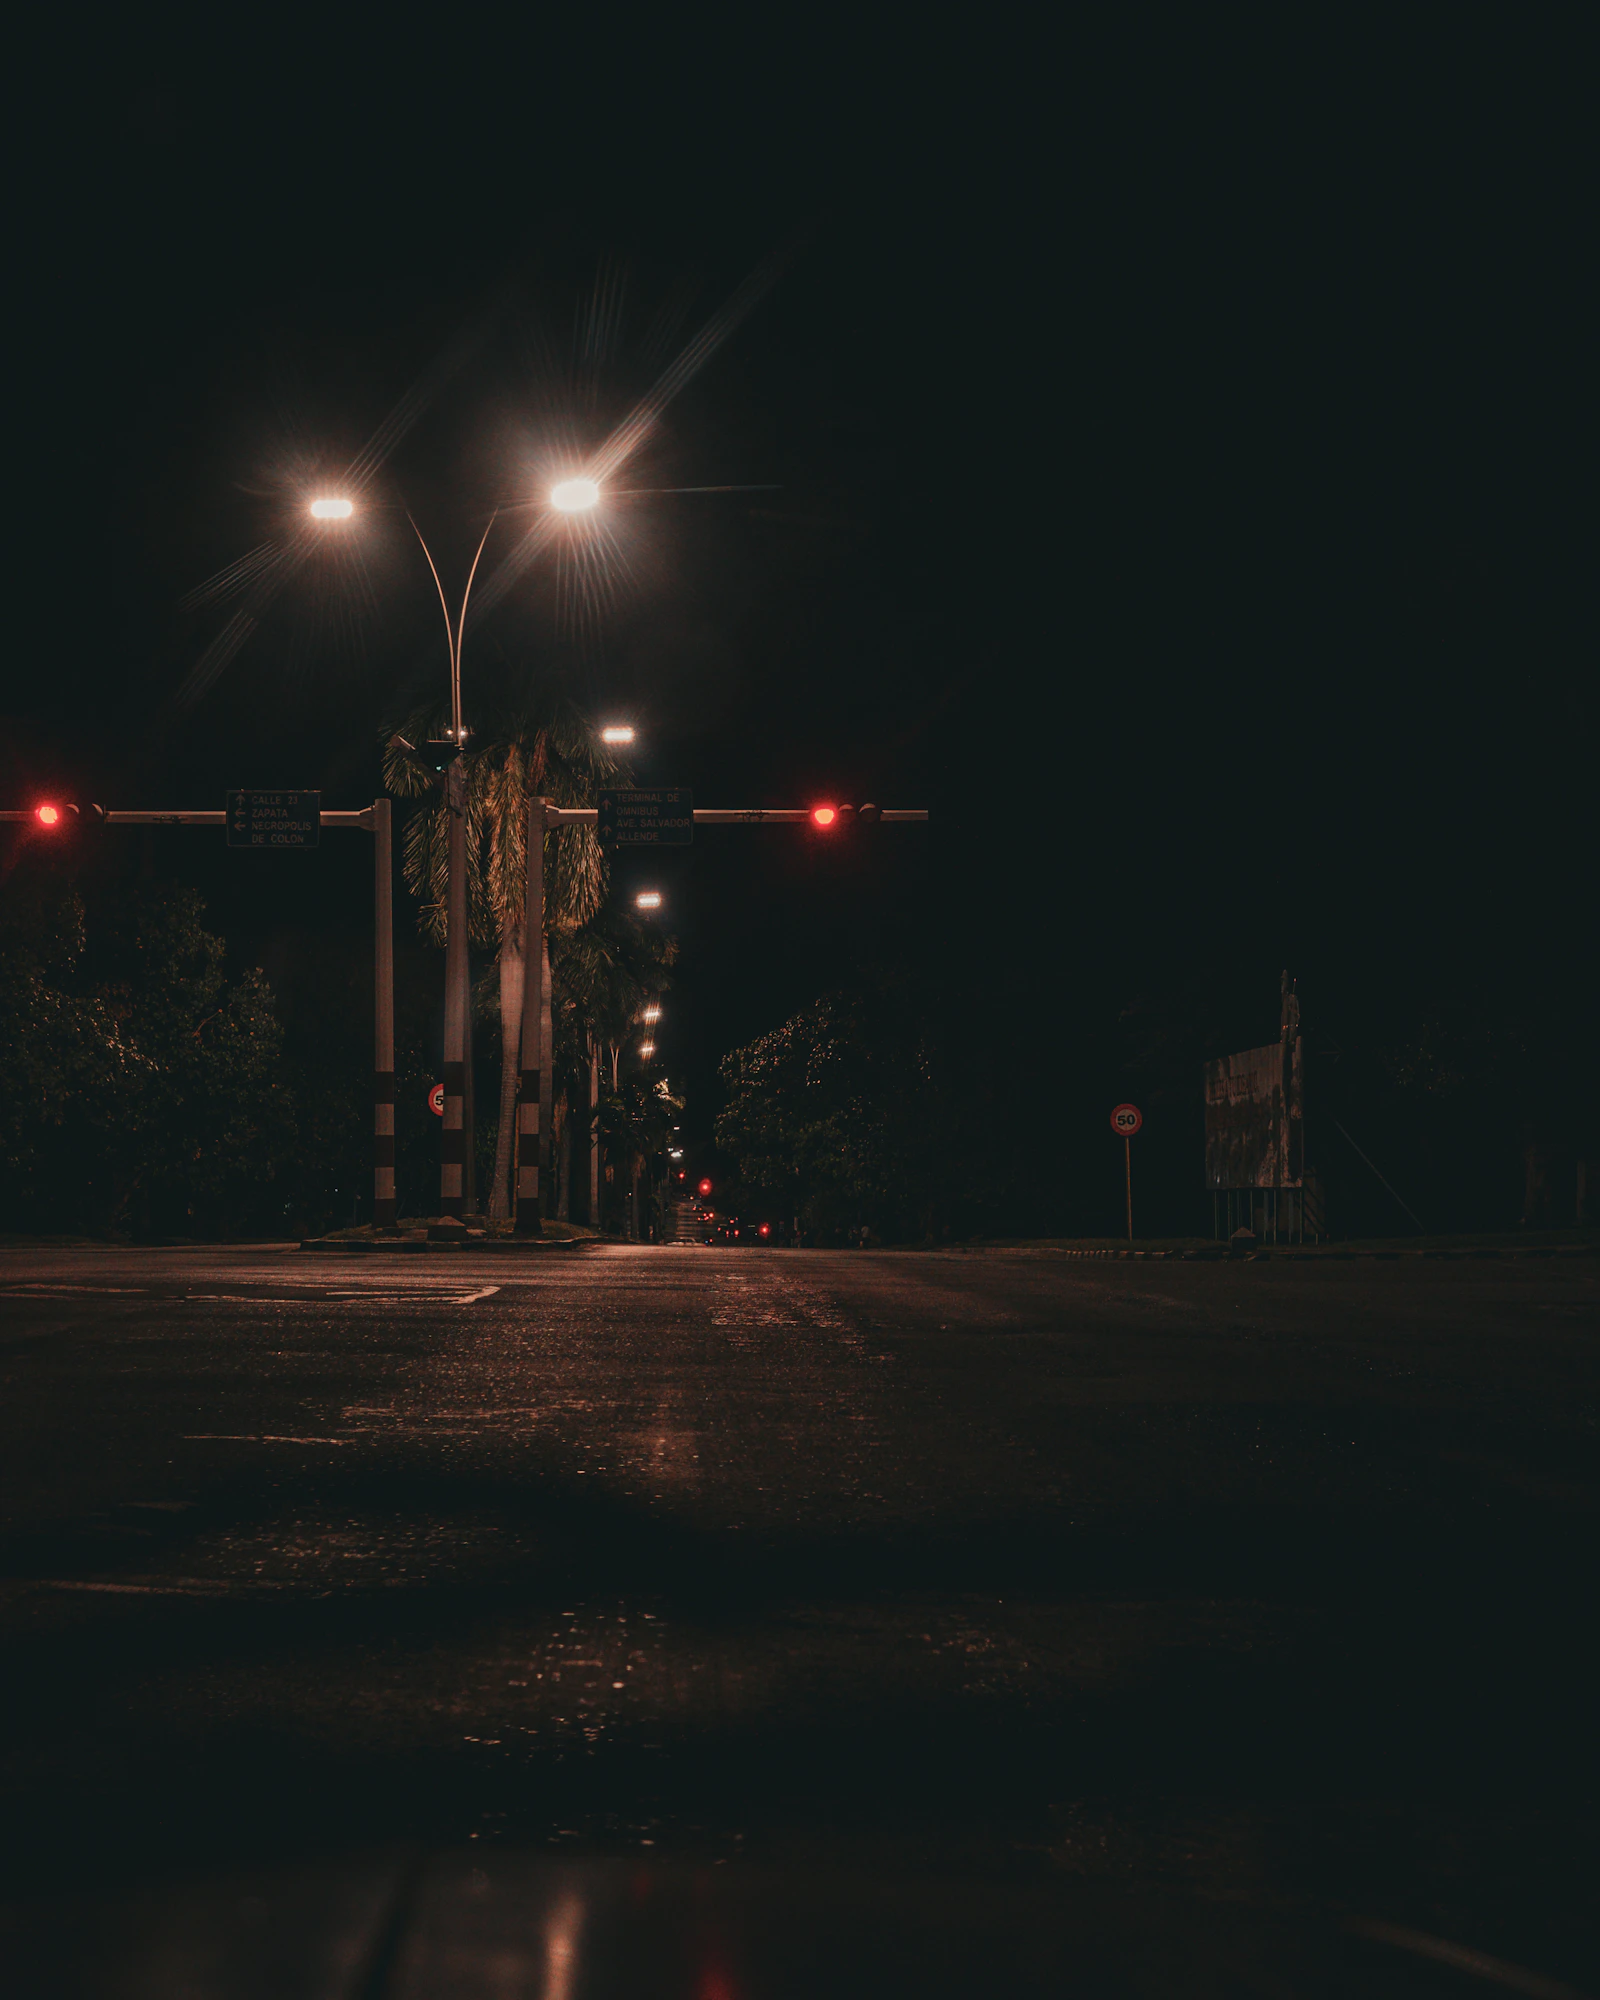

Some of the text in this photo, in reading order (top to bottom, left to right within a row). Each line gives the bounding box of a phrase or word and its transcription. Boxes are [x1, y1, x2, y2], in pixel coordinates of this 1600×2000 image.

[251, 795, 298, 805] CALLE 23
[616, 793, 680, 803] TERMINAL DE
[251, 808, 289, 818] ZAPATA
[616, 806, 659, 816] OMNIBUS
[251, 821, 312, 831] NECROPOLIS
[616, 818, 690, 828] AVE. SALVADOR
[251, 833, 304, 843] DE COLON
[616, 831, 660, 841] ALLENDE
[435, 1095, 444, 1106] 5
[1117, 1114, 1136, 1126] 50
